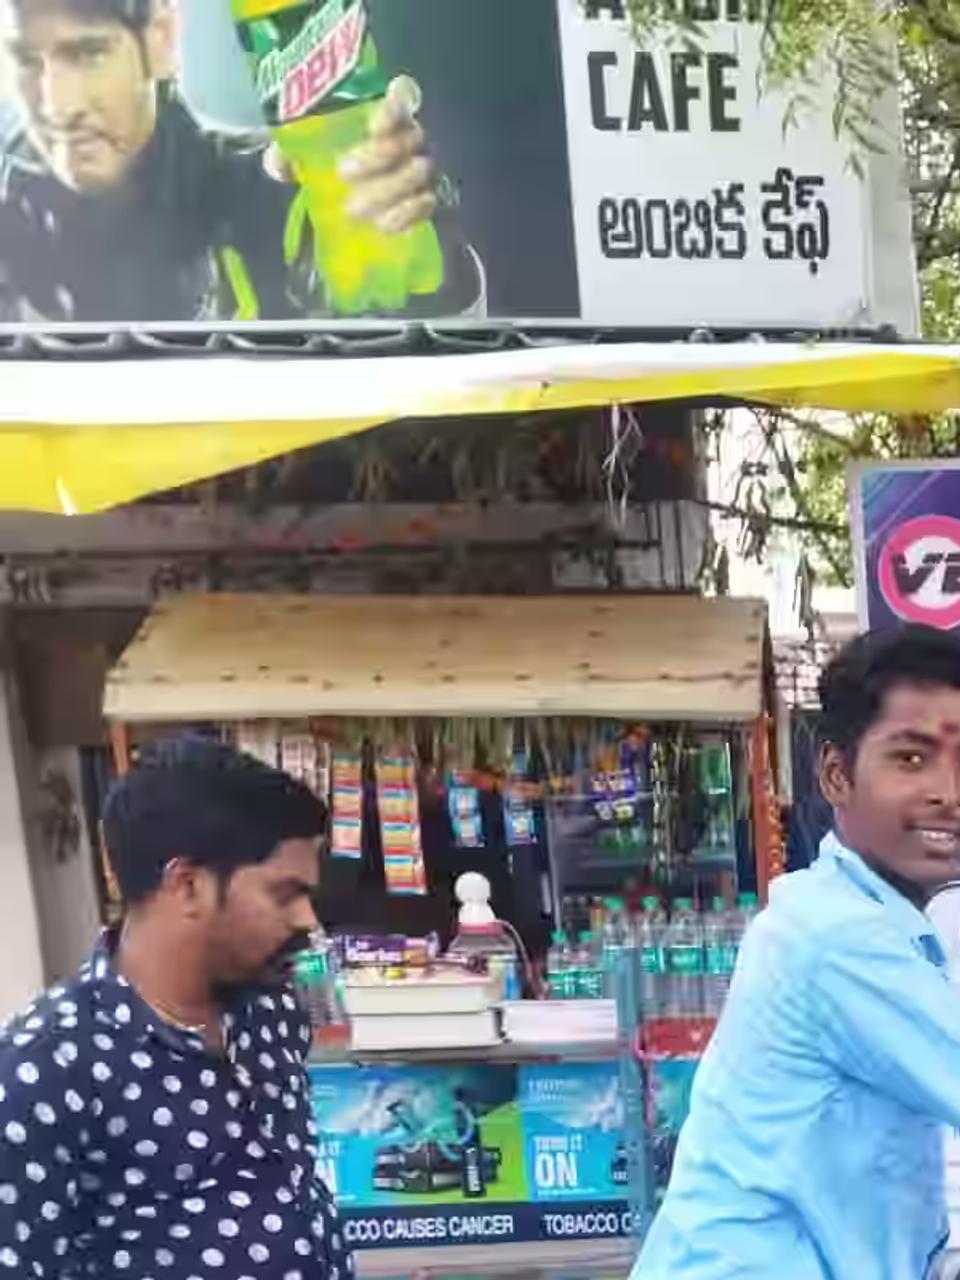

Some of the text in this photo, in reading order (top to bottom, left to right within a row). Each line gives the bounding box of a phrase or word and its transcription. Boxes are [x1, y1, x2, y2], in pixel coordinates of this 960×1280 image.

[587, 51, 741, 131] CAFE
[599, 166, 829, 274] అంబిక కేఫ్
[534, 1152, 578, 1188] ON
[383, 1217, 446, 1239] CAUSES
[448, 1214, 514, 1237] CANCER
[543, 1213, 618, 1235] TOBACCO
